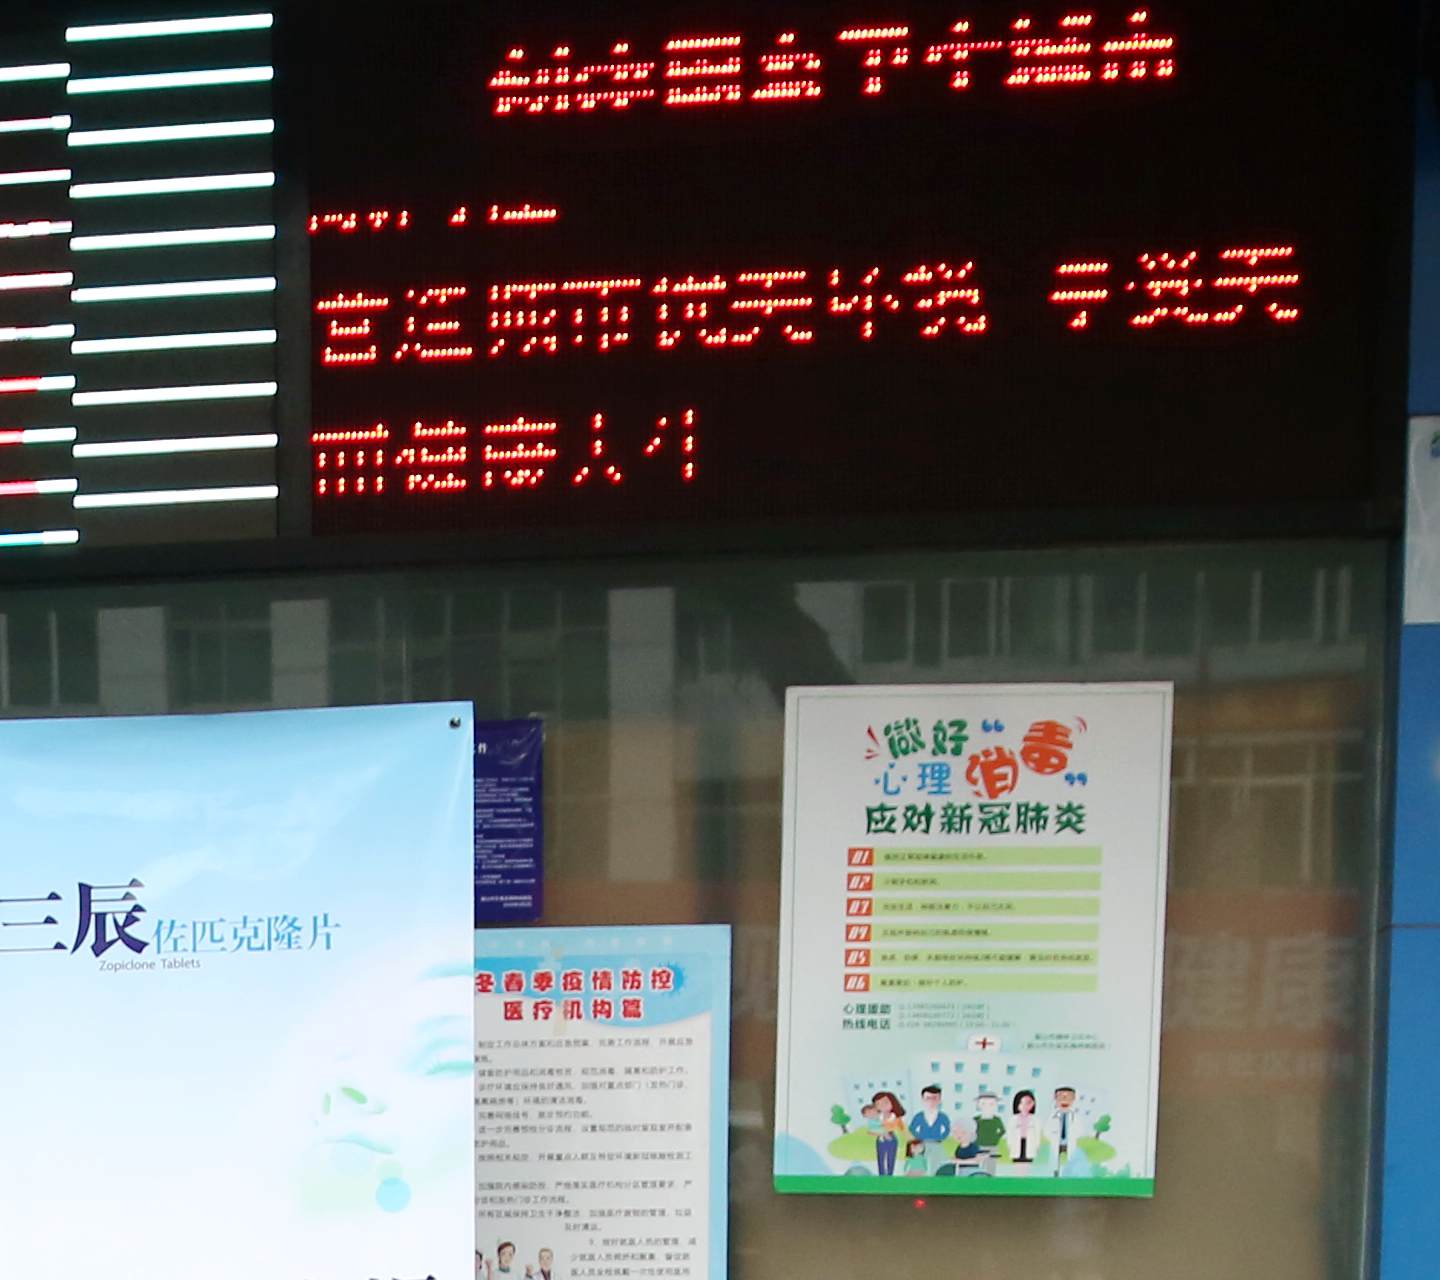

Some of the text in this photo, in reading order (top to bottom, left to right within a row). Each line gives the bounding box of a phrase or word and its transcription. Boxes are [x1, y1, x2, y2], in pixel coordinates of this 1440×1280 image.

[874, 762, 952, 796] 心理
[865, 800, 1087, 835] 应对新冠肺炎
[152, 912, 342, 954] 佐匹克隆片
[99, 957, 201, 973] Zopiclone Tablets
[504, 999, 643, 1021] 医疗机构篇
[842, 1018, 891, 1030] 热线电话
